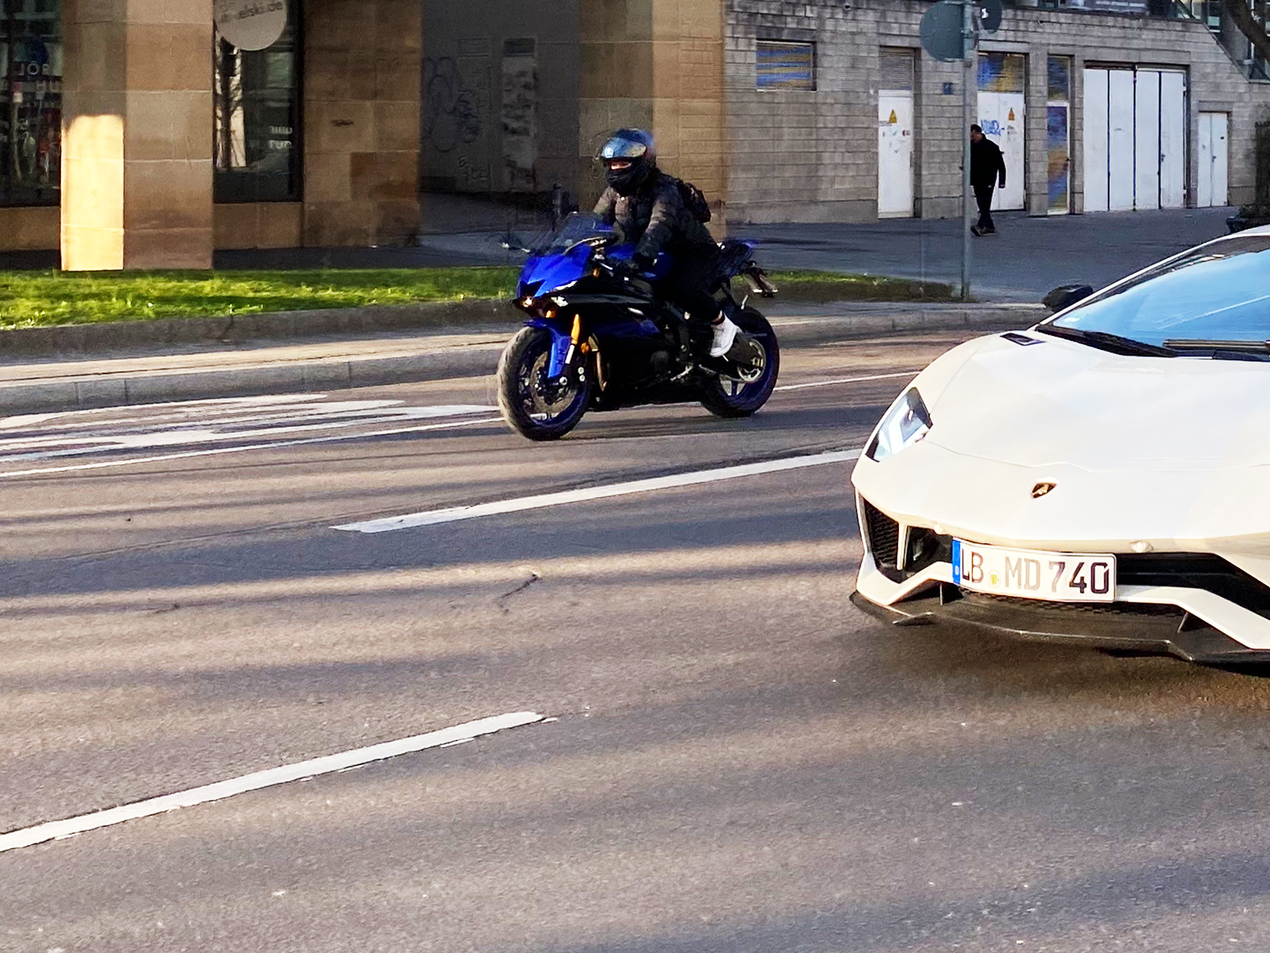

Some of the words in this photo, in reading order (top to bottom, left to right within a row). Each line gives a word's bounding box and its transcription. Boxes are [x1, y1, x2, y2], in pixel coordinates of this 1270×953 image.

[961, 547, 985, 584] LB
[1004, 556, 1041, 591] MD
[1048, 561, 1110, 595] 740
